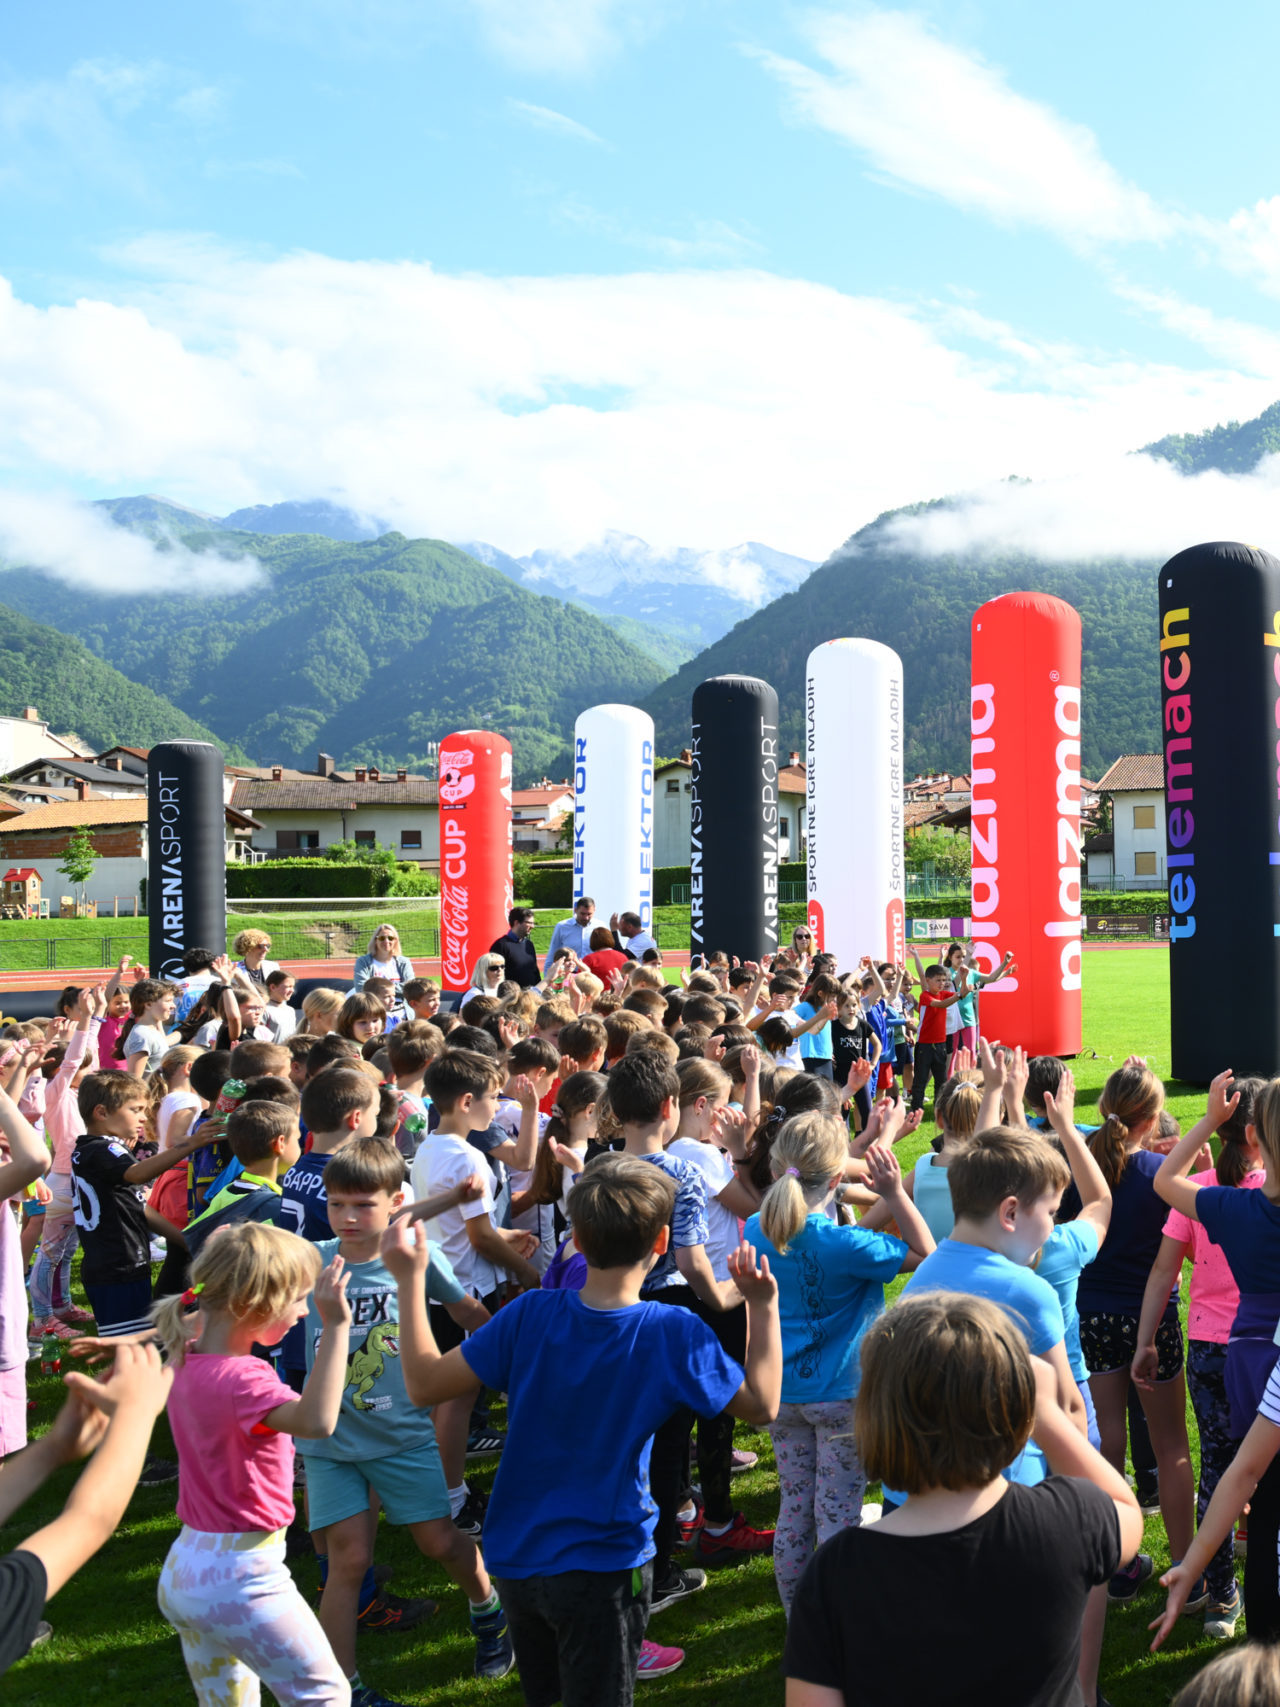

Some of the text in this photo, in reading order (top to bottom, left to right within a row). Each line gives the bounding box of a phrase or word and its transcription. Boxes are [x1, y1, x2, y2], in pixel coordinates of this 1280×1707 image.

[806, 677, 816, 752] MLADIH
[889, 679, 899, 752] MLADIH
[444, 789, 463, 798] CUP
[807, 757, 817, 800] IGRE
[890, 757, 900, 800] IGRE
[1160, 607, 1197, 943] telemach
[158, 770, 185, 950] ARENASPORT
[444, 818, 467, 880] CUP
[573, 737, 587, 912] LEKTOR
[639, 740, 653, 928] OLEKTOR
[761, 716, 778, 942] ARENASPORT
[889, 804, 900, 892] ŠPORTNE
[971, 683, 1019, 993] plazma
[1044, 684, 1081, 991] plazma
[929, 923, 949, 931] SAVA
